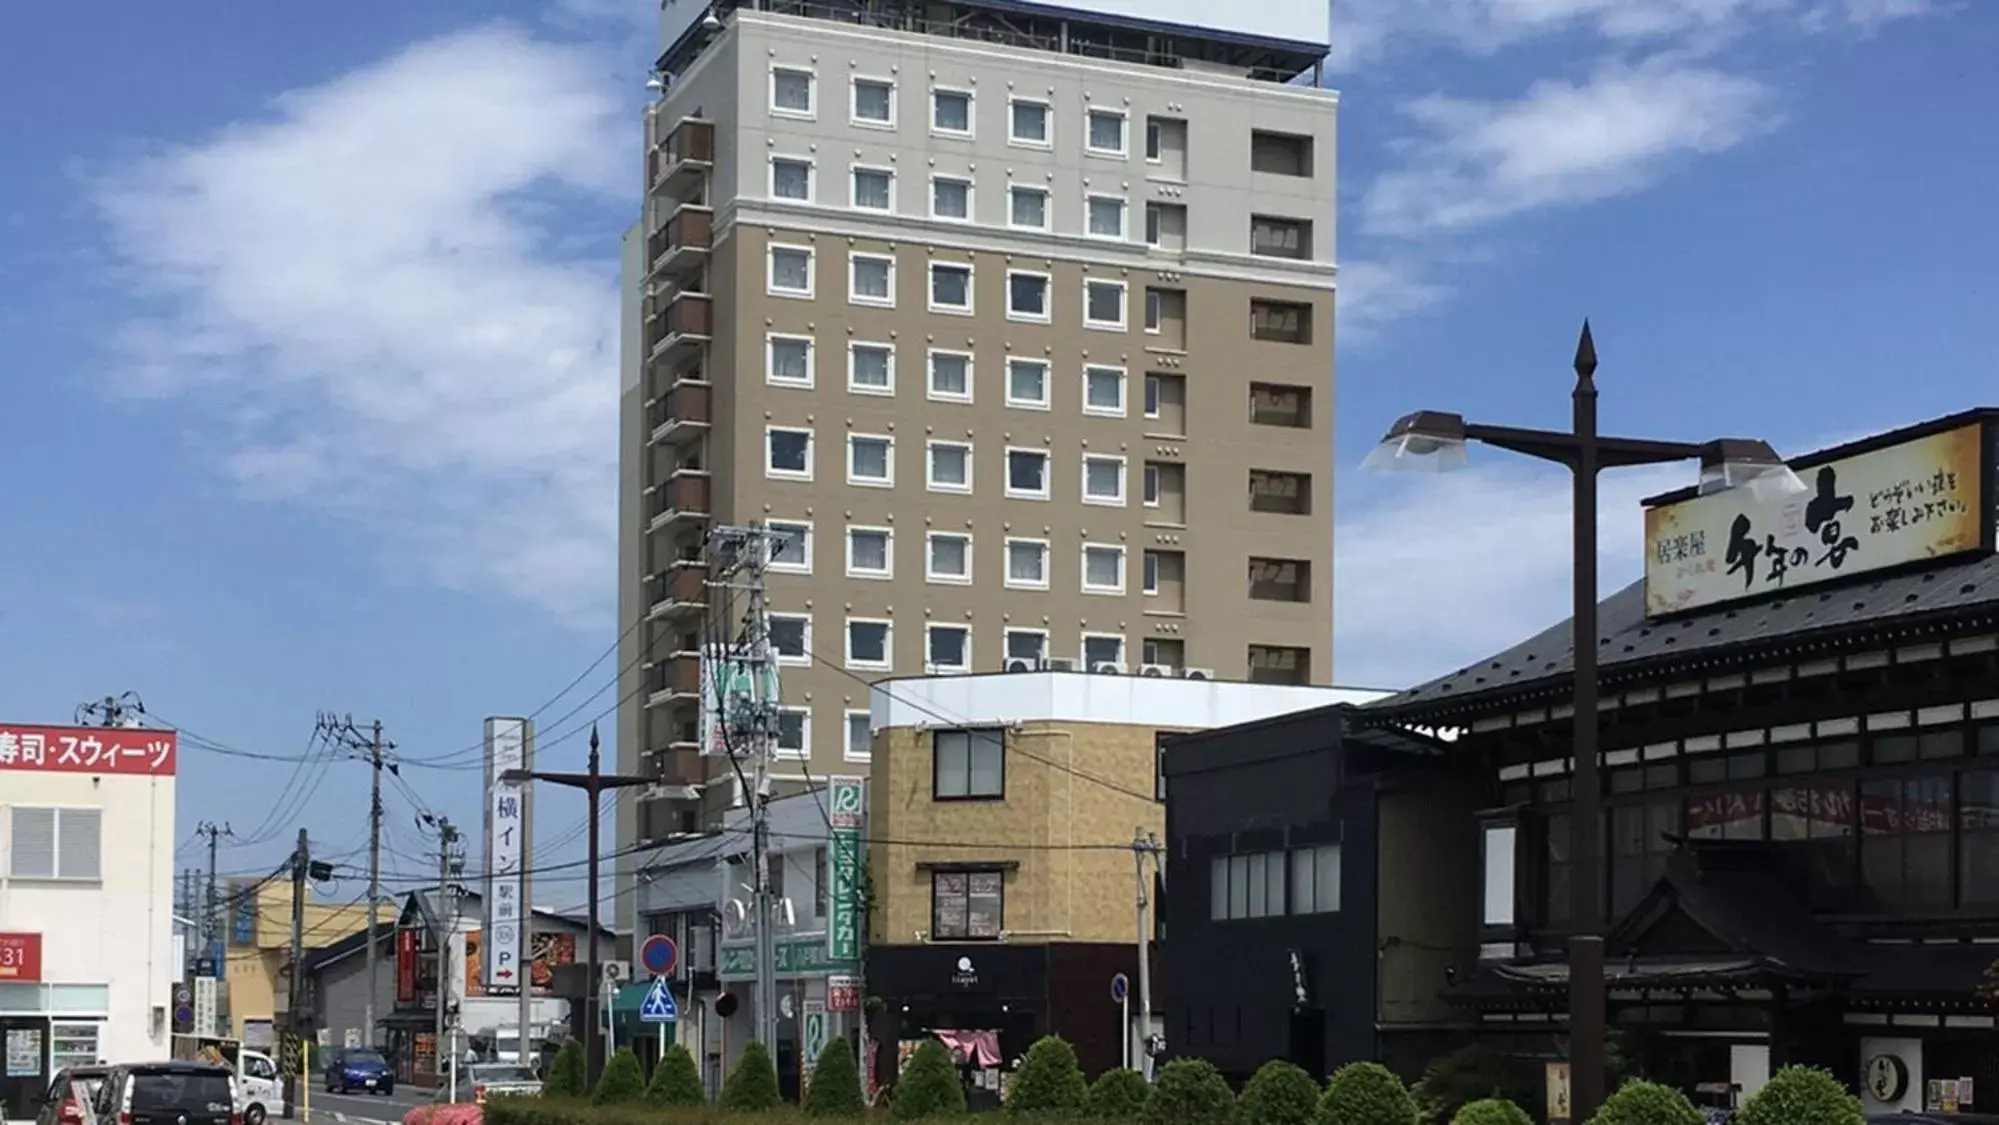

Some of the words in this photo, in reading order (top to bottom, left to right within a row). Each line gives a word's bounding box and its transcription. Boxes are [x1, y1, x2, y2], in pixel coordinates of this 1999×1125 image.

[1726, 466, 1859, 590] 千年の宴
[1657, 531, 1706, 566] 居楽屋
[0, 948, 23, 966] 31
[499, 951, 512, 966] P
